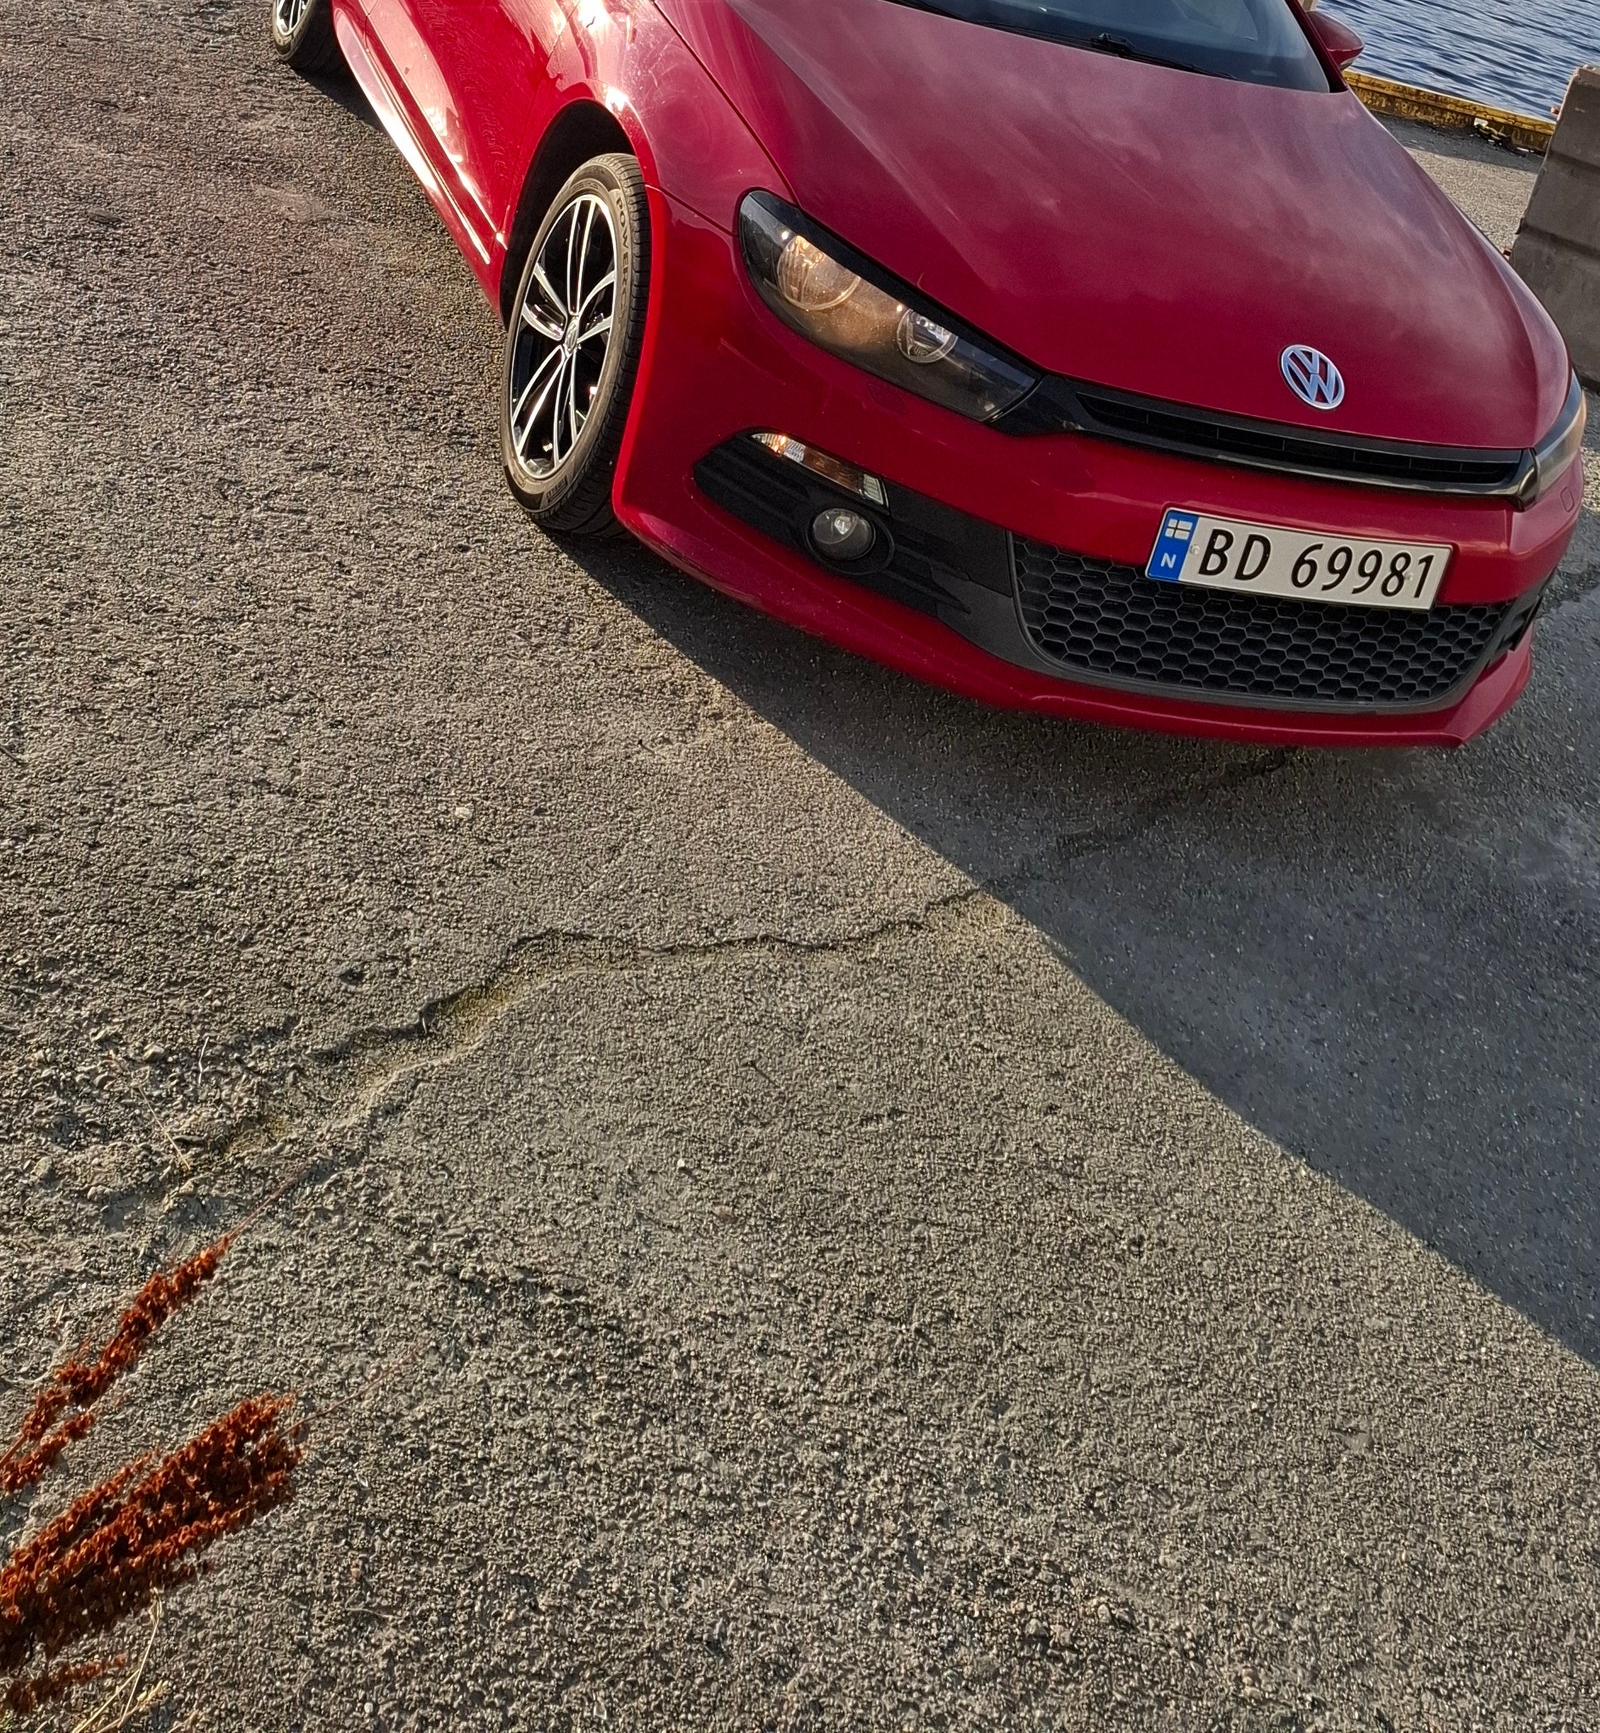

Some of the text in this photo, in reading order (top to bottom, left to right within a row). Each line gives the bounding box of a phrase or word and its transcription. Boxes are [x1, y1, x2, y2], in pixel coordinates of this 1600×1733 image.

[1281, 345, 1344, 409] VW
[1160, 552, 1177, 569] N
[1198, 528, 1434, 599] BD 69981
